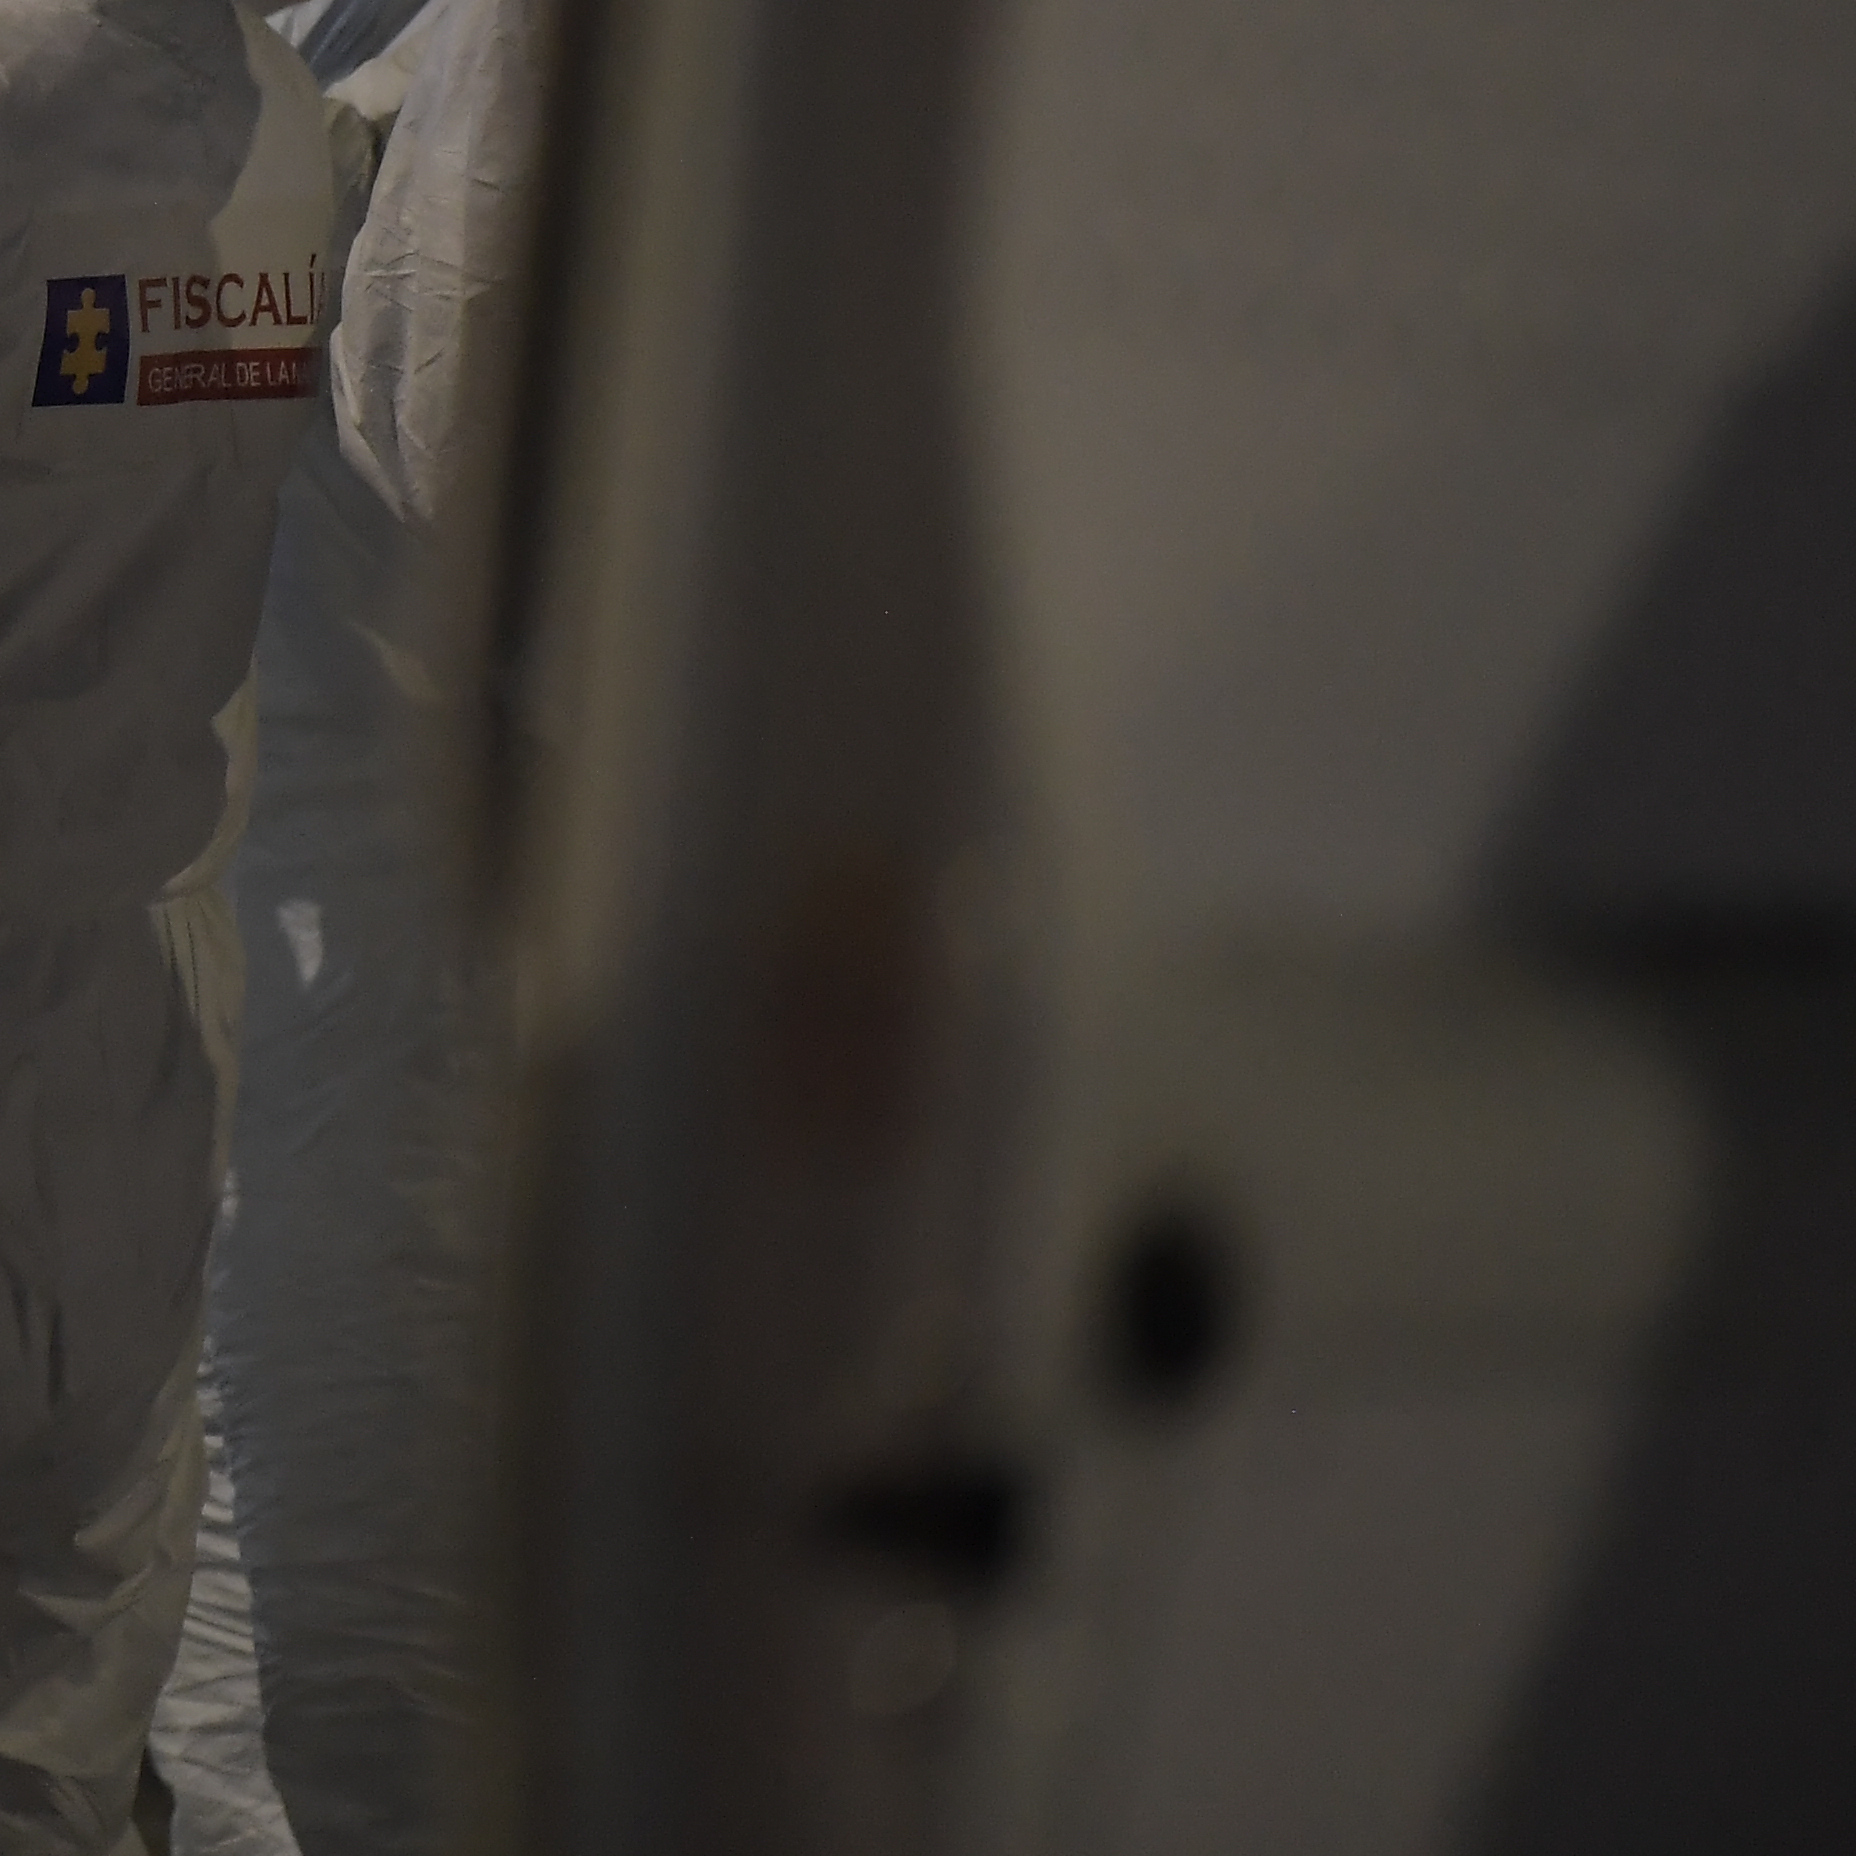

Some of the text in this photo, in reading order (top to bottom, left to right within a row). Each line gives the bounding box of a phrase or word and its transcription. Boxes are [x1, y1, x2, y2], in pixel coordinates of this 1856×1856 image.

[138, 253, 326, 333] FISCALÍ
[148, 362, 232, 393] GENERAL
[236, 361, 262, 388] DE
[266, 360, 291, 386] LA
